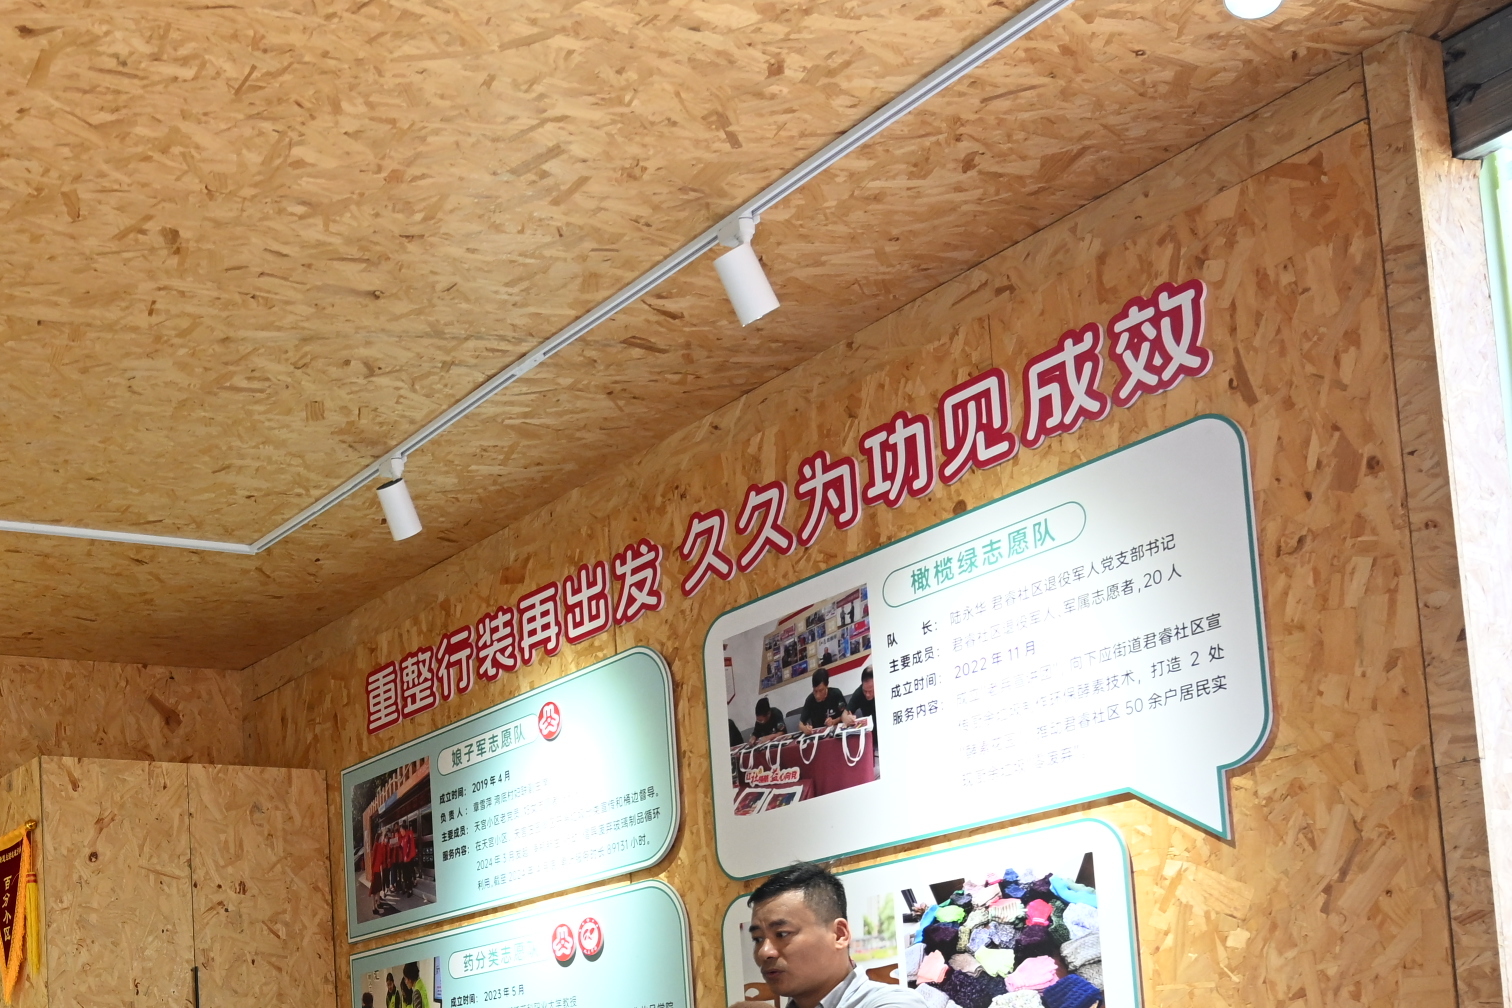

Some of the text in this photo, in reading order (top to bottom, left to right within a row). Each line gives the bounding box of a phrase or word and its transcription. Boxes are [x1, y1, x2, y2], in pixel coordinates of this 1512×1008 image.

[369, 281, 1211, 733] 重整行装再出发 久久为功见成效
[910, 518, 1056, 594] 橄榄绿志愿队
[452, 725, 525, 768] 娘子军志愿队
[1, 875, 12, 941] 百分小区
